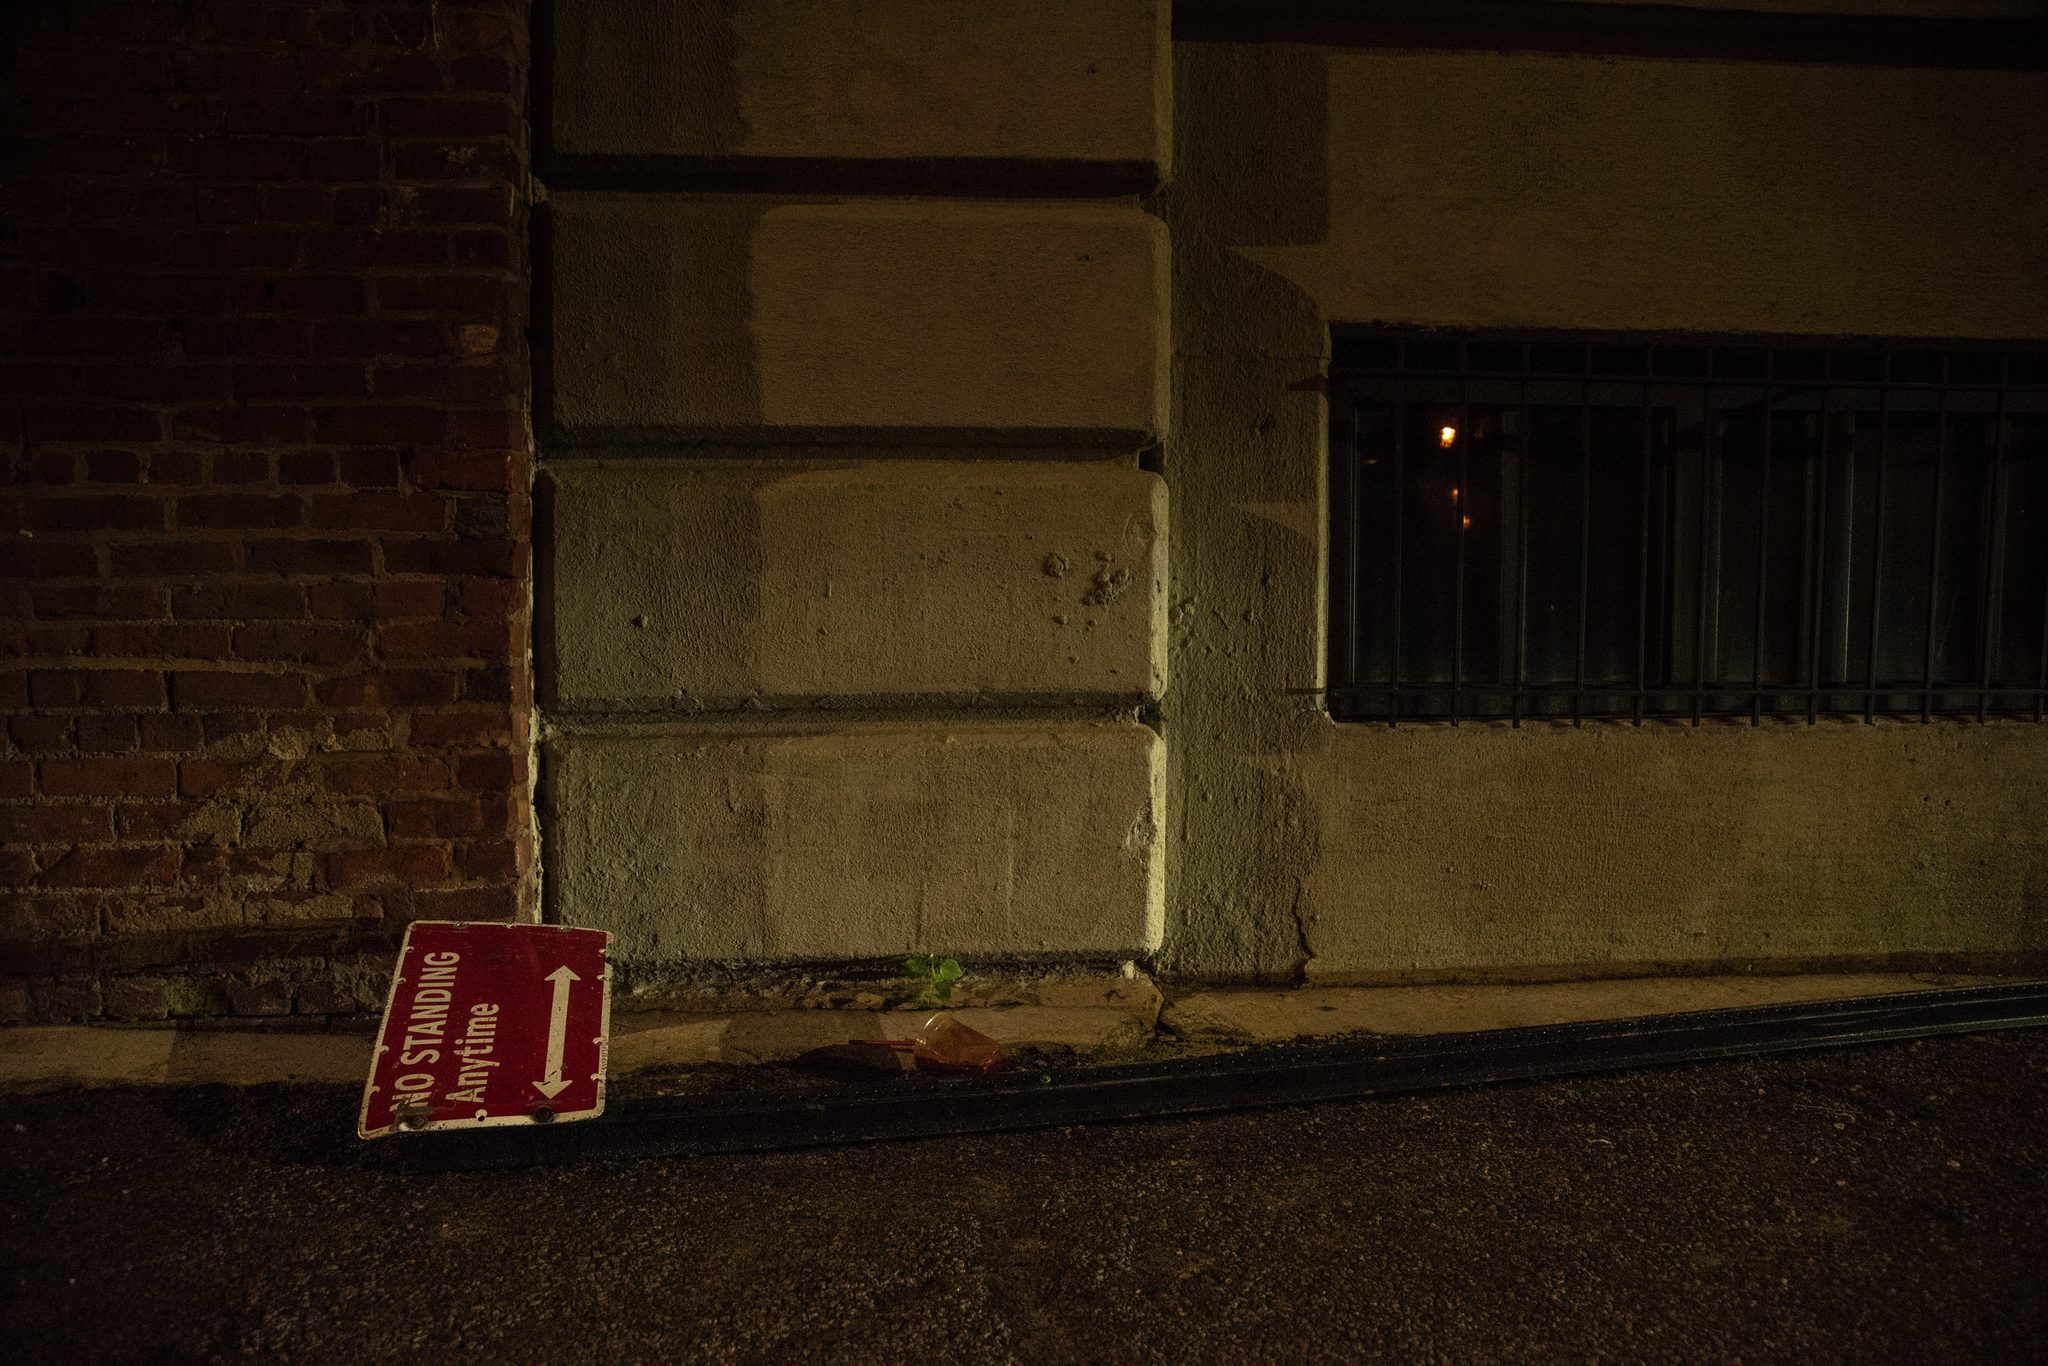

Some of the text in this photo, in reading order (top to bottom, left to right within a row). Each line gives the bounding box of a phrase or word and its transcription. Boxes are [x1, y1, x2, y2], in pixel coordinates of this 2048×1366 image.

[389, 951, 461, 1112] NO STANDING
[445, 1003, 500, 1103] Anytime
